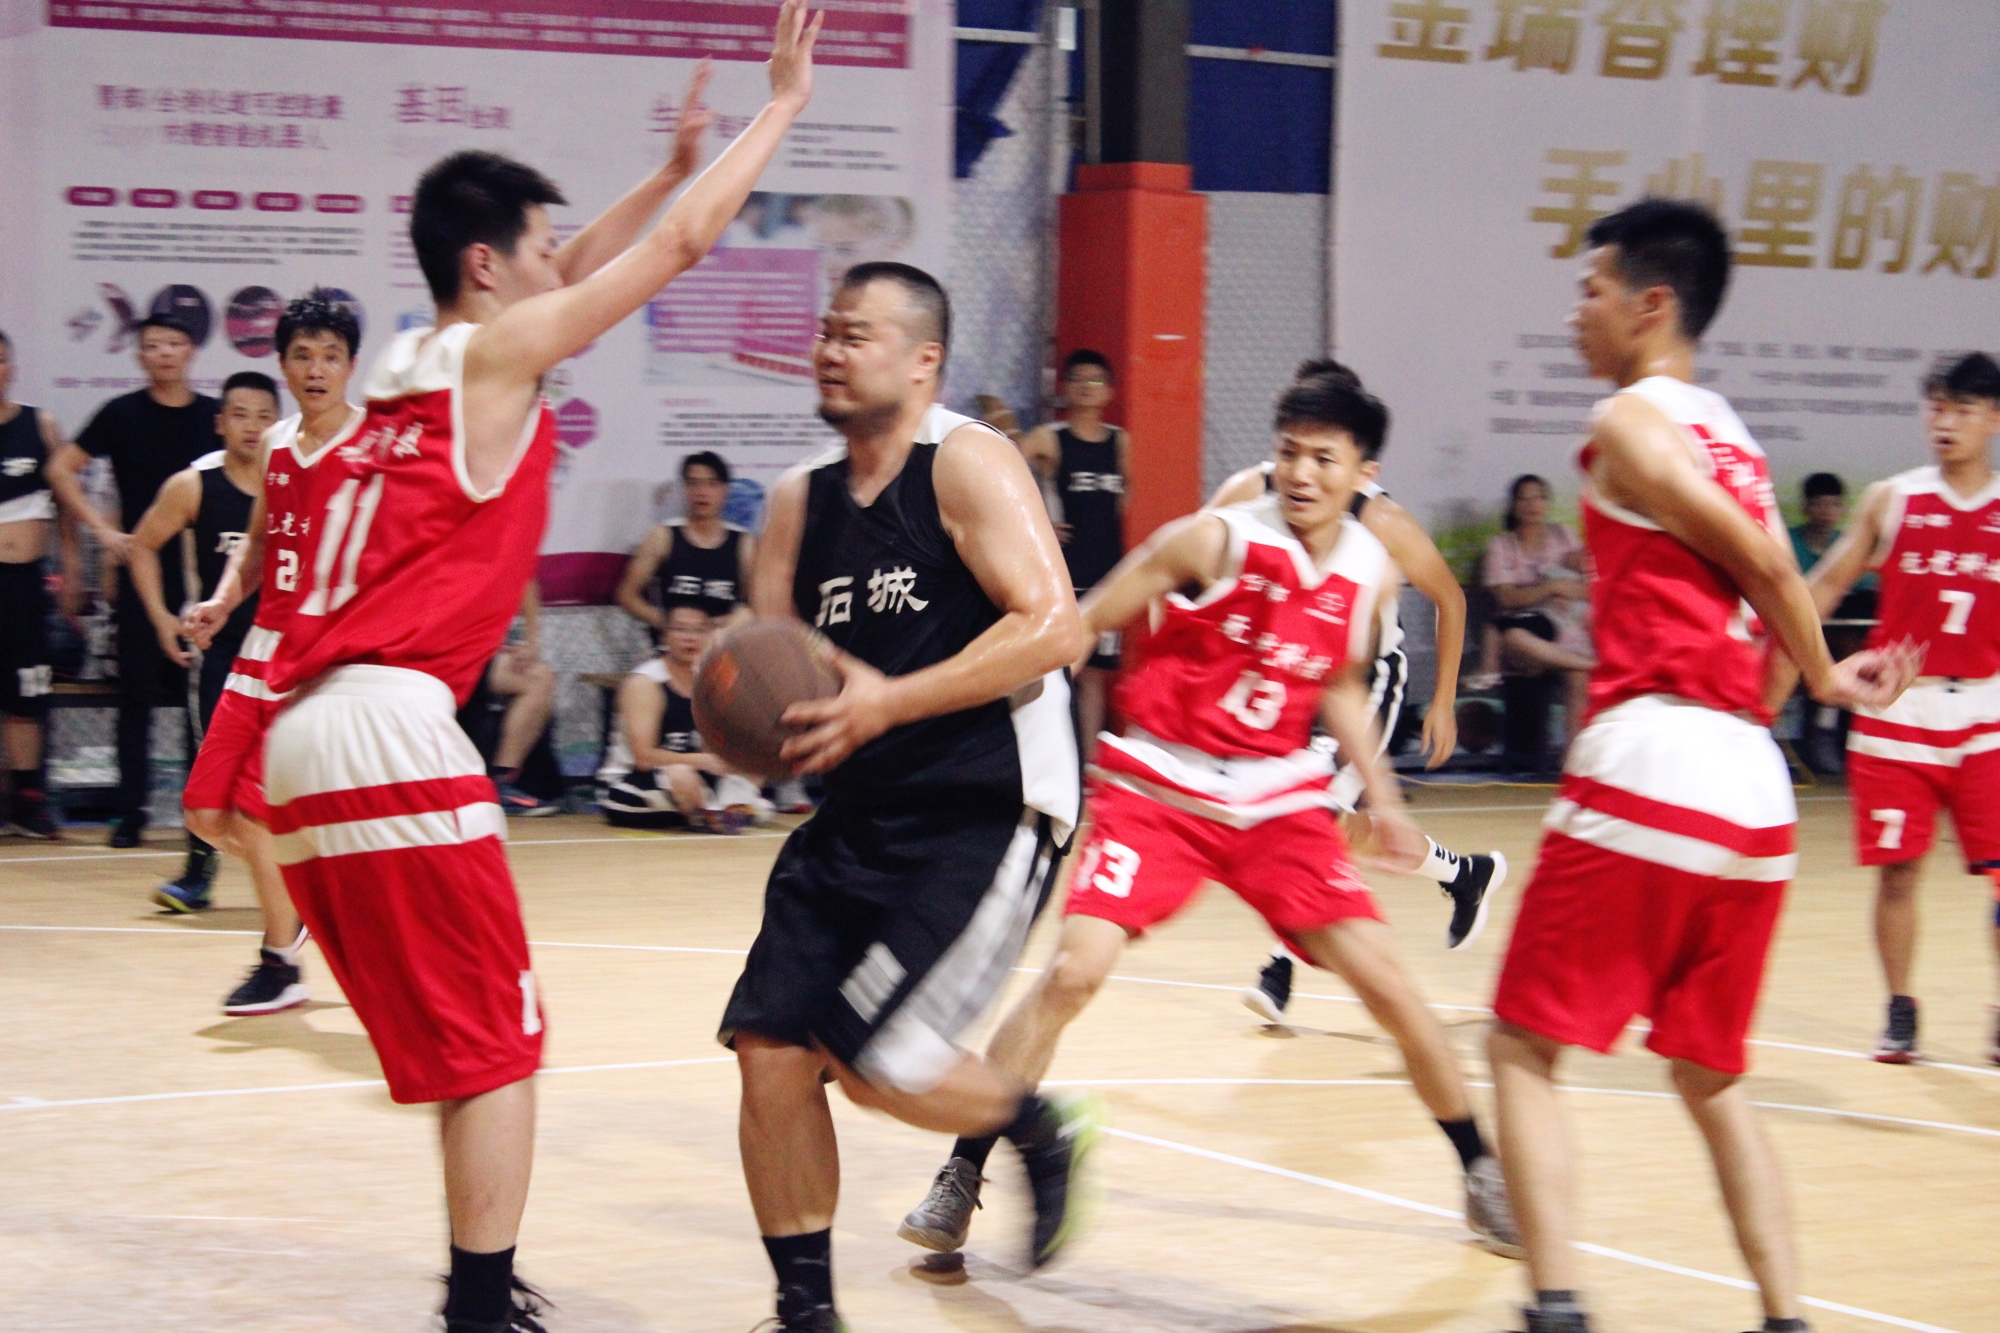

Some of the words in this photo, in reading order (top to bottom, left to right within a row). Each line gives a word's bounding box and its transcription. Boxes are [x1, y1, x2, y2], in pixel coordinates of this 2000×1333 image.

[297, 472, 386, 617] 11
[815, 565, 930, 628] 石城
[1938, 589, 1976, 635] 7
[1215, 669, 1288, 732] 13
[1870, 808, 1907, 849] 7
[1074, 838, 1142, 898] 13
